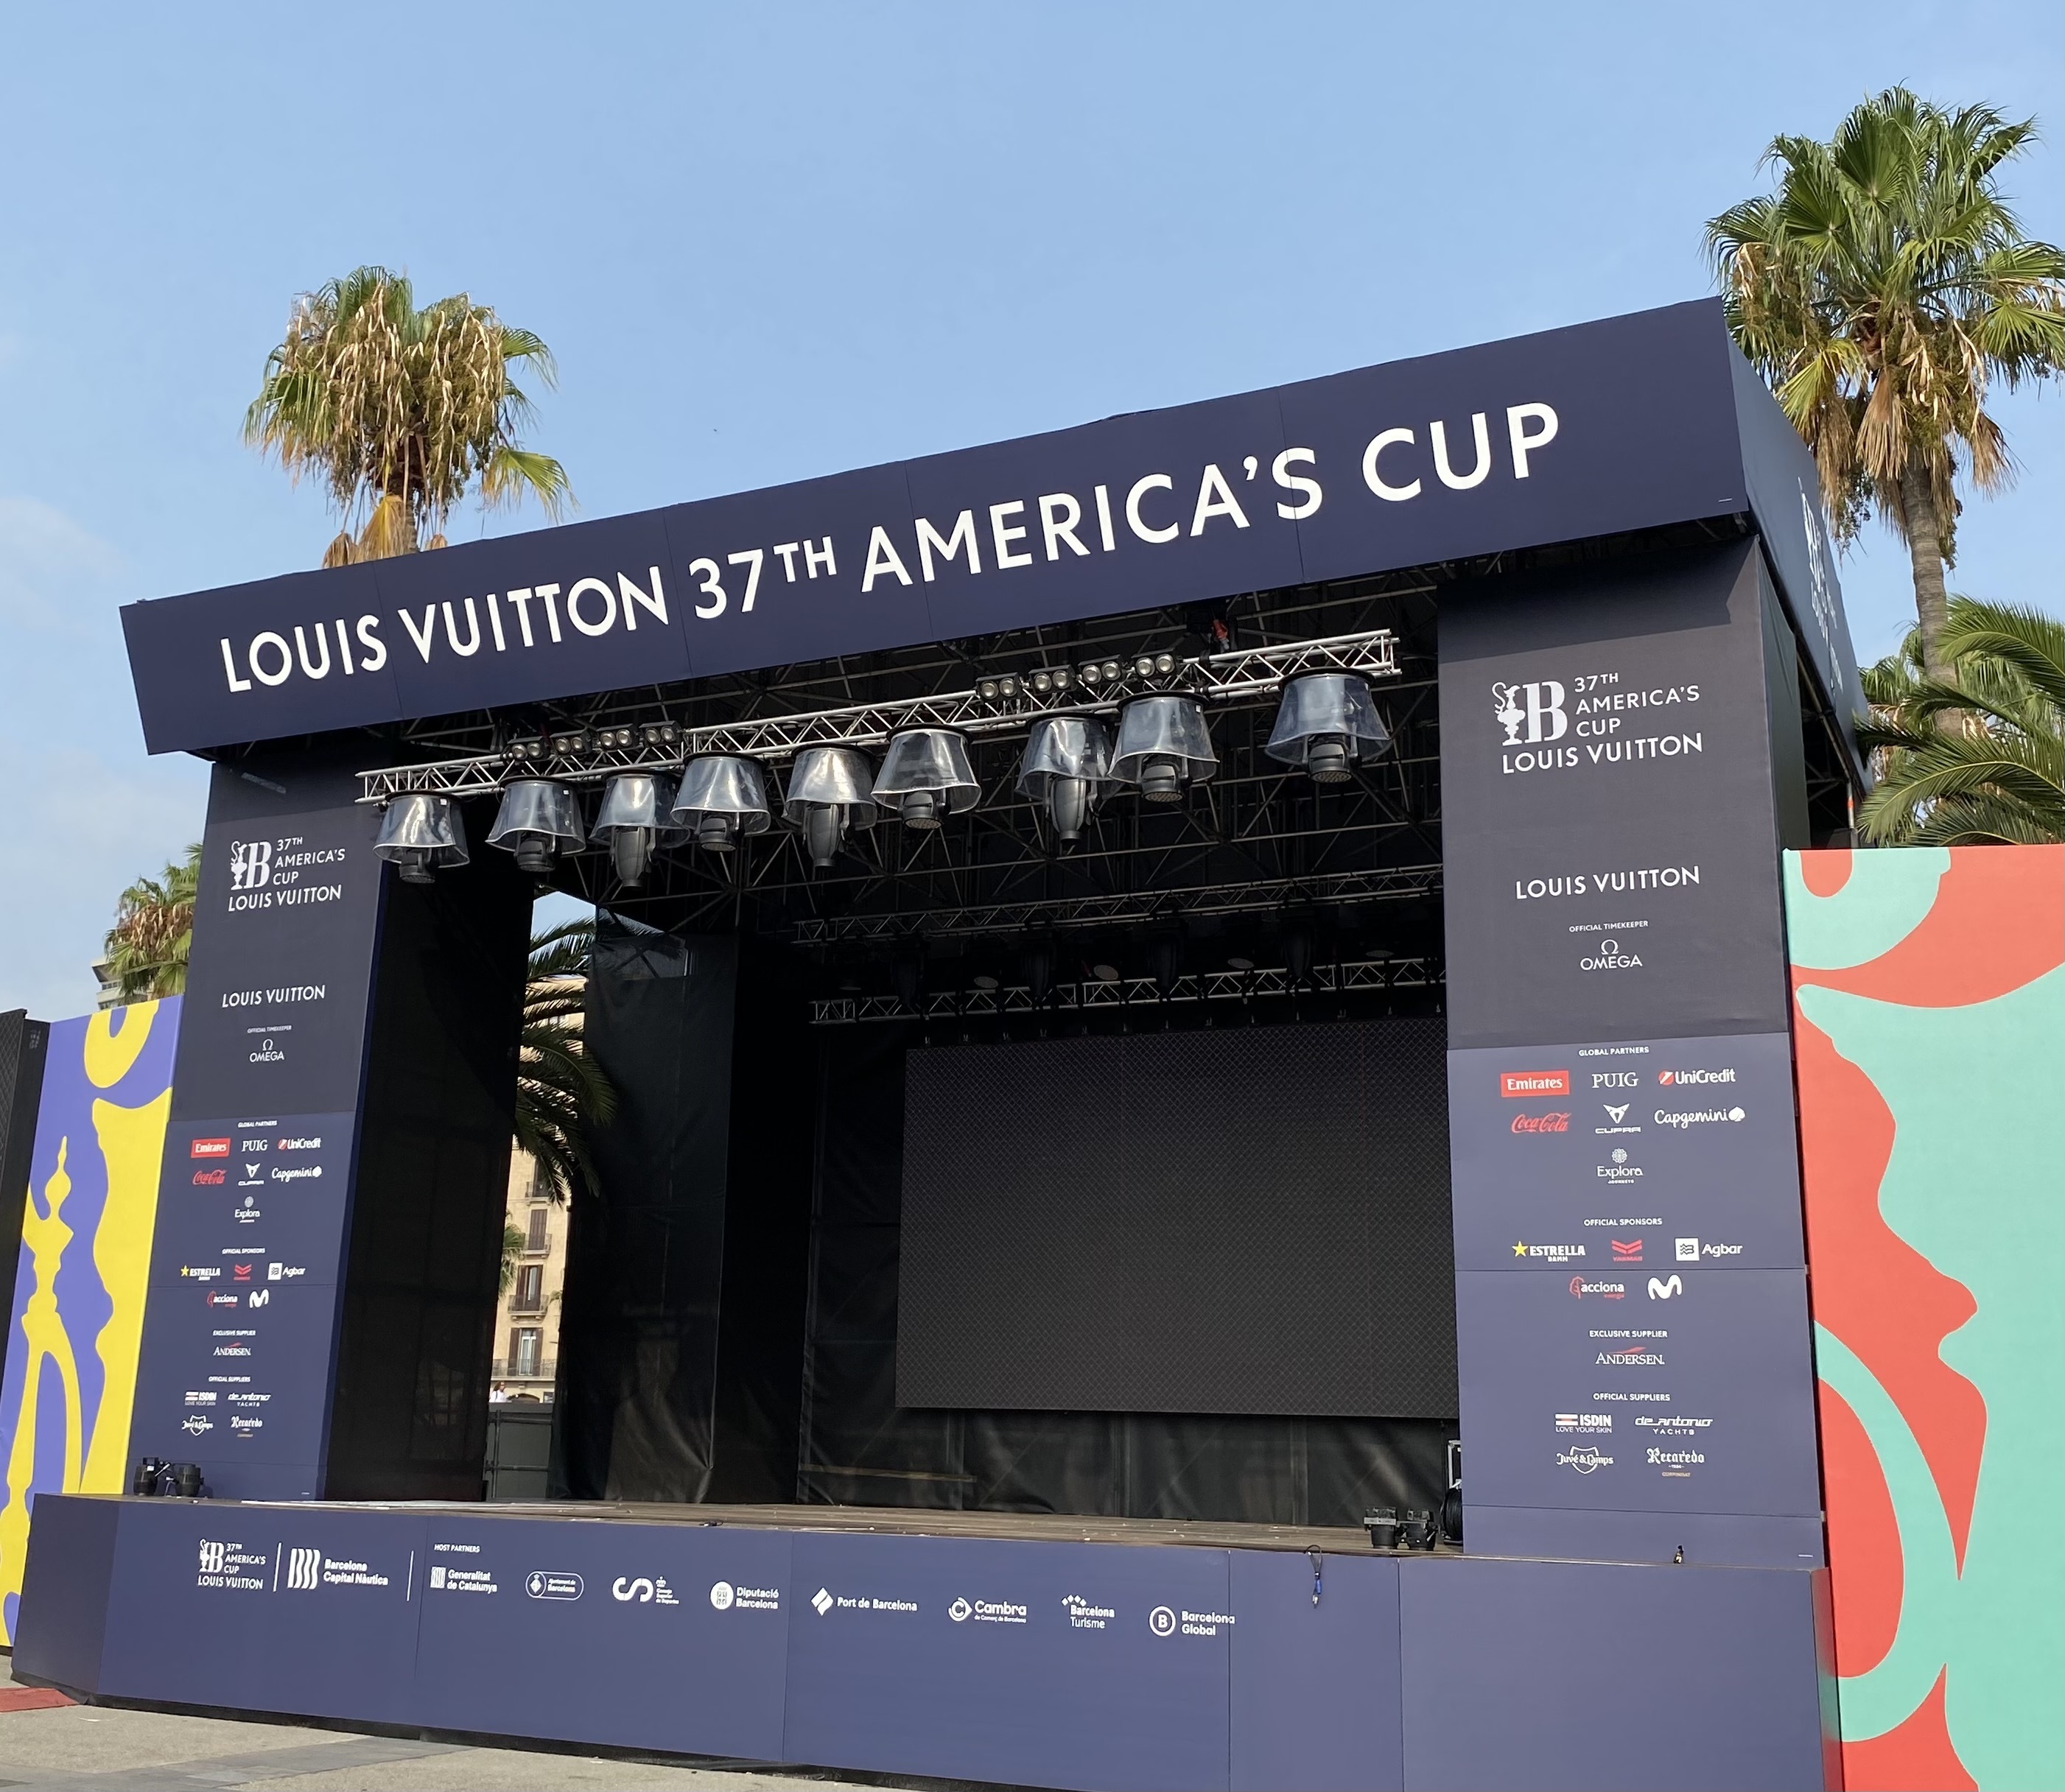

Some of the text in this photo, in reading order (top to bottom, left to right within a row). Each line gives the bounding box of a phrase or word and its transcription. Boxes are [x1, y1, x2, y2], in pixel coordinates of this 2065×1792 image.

[221, 403, 1558, 692] LOUIS VUITTON 37TH AMERICA'S CUP
[1575, 672, 1618, 692] 37TH
[1575, 685, 1699, 714] AMERICA'S
[1577, 718, 1620, 737] CUP
[1503, 733, 1702, 773] LOUIS VUITTON
[277, 837, 302, 851] 37TH
[275, 848, 345, 868] AMERICA'S
[273, 871, 298, 885] CUP
[1517, 866, 1699, 899] LOUIS VUITTON
[228, 885, 341, 911] LOUIS VUITTON
[1568, 920, 1649, 932] OFFICIAL TIMEKEEPER
[1580, 955, 1642, 970] OMEGA
[222, 985, 325, 1008] LOUIS VUITTON
[250, 1051, 284, 1062] OMEGA
[1578, 1046, 1649, 1057] GLOBAL PARTNERS
[1592, 1072, 1638, 1088] PUIG
[1675, 1069, 1736, 1084] UniCredit
[1507, 1078, 1563, 1090] Emirates
[1655, 1108, 1728, 1128] Capgemini
[195, 1142, 226, 1153] Emirates
[242, 1139, 267, 1151] PUIG
[287, 1138, 320, 1149] UniCredit
[272, 1167, 312, 1182] Capgemini
[1597, 1166, 1643, 1178] Explora
[234, 1209, 261, 1220] Explora
[1583, 1217, 1663, 1226] OFFICIAL SPONSORS
[1530, 1245, 1585, 1256] ESTRELLA
[1702, 1244, 1742, 1257] Agbar
[189, 1268, 221, 1277] ESTRELLA
[283, 1267, 305, 1277] Agbar
[1581, 1282, 1624, 1292] acciona
[1589, 1329, 1630, 1338] EXCLUSIVE
[1593, 1392, 1671, 1402] OFFICIAL SUPPLIERS
[1580, 1415, 1611, 1426] ISDIN
[434, 1544, 480, 1553] HOST PARTNERS
[225, 1554, 266, 1564] AMERICA'S
[325, 1559, 367, 1571] Barcelona
[223, 1564, 240, 1574] CUP
[323, 1571, 354, 1584] Capital
[448, 1570, 491, 1581] Generalitat
[198, 1575, 263, 1589] LOUIS VUITTON
[446, 1579, 497, 1593] de Catalunya
[737, 1587, 779, 1600] Diputació
[736, 1598, 778, 1609] Barcelona
[838, 1597, 916, 1611] Port de Barcelona
[975, 1600, 1026, 1615] Cambra
[1070, 1605, 1115, 1618] Barcelona
[1182, 1612, 1235, 1623] Barcelona
[1070, 1617, 1105, 1628] Turisme
[1182, 1624, 1216, 1635] Global
